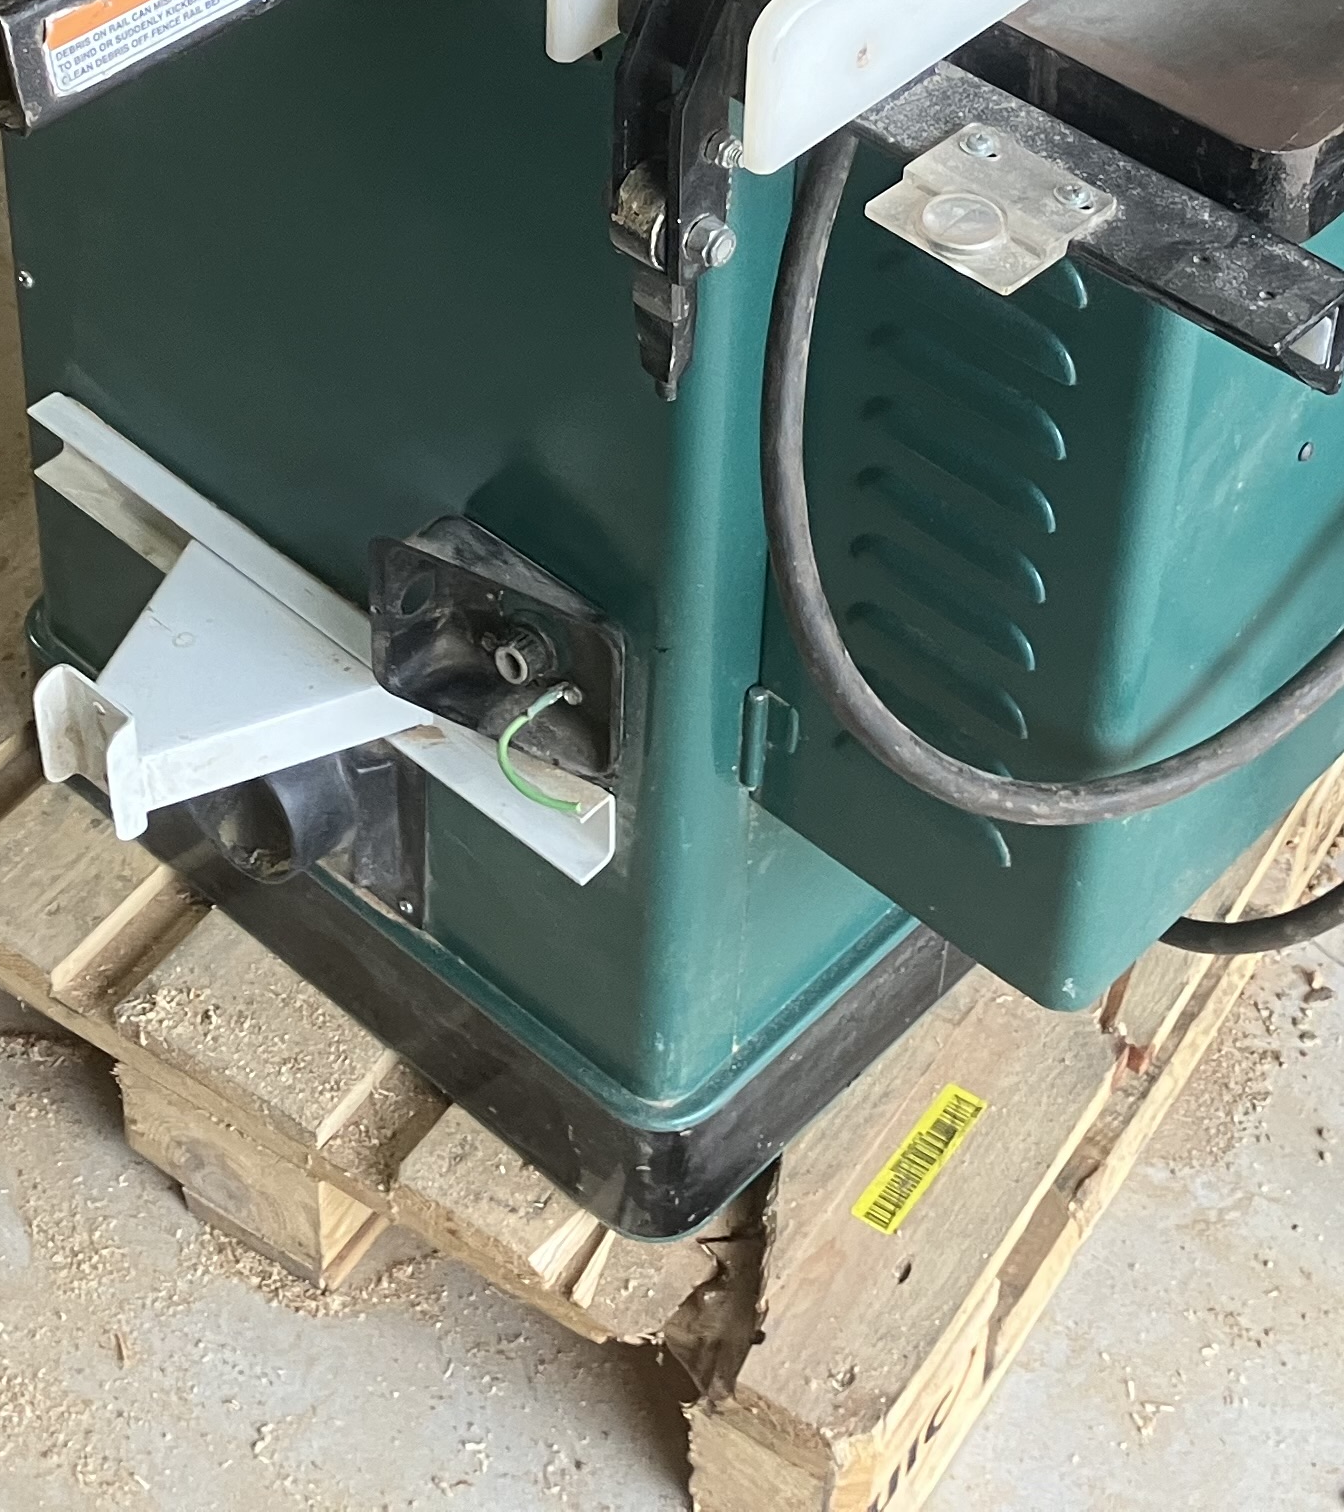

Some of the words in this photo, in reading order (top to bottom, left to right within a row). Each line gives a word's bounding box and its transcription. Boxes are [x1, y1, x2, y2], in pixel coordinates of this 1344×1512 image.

[55, 36, 91, 61] DEBRIS
[92, 27, 107, 42] ON
[108, 15, 130, 34] RAIL
[131, 4, 152, 22] CAN
[57, 58, 72, 74] TO
[73, 45, 97, 66] BIND
[98, 37, 114, 52] OR
[114, 11, 164, 44] SUDDENLY
[60, 61, 94, 86] CLEAN
[94, 42, 130, 68] DEBRIS
[130, 31, 150, 49] OFF
[151, 15, 181, 38] FENCE
[182, 3, 203, 21] RAIL
